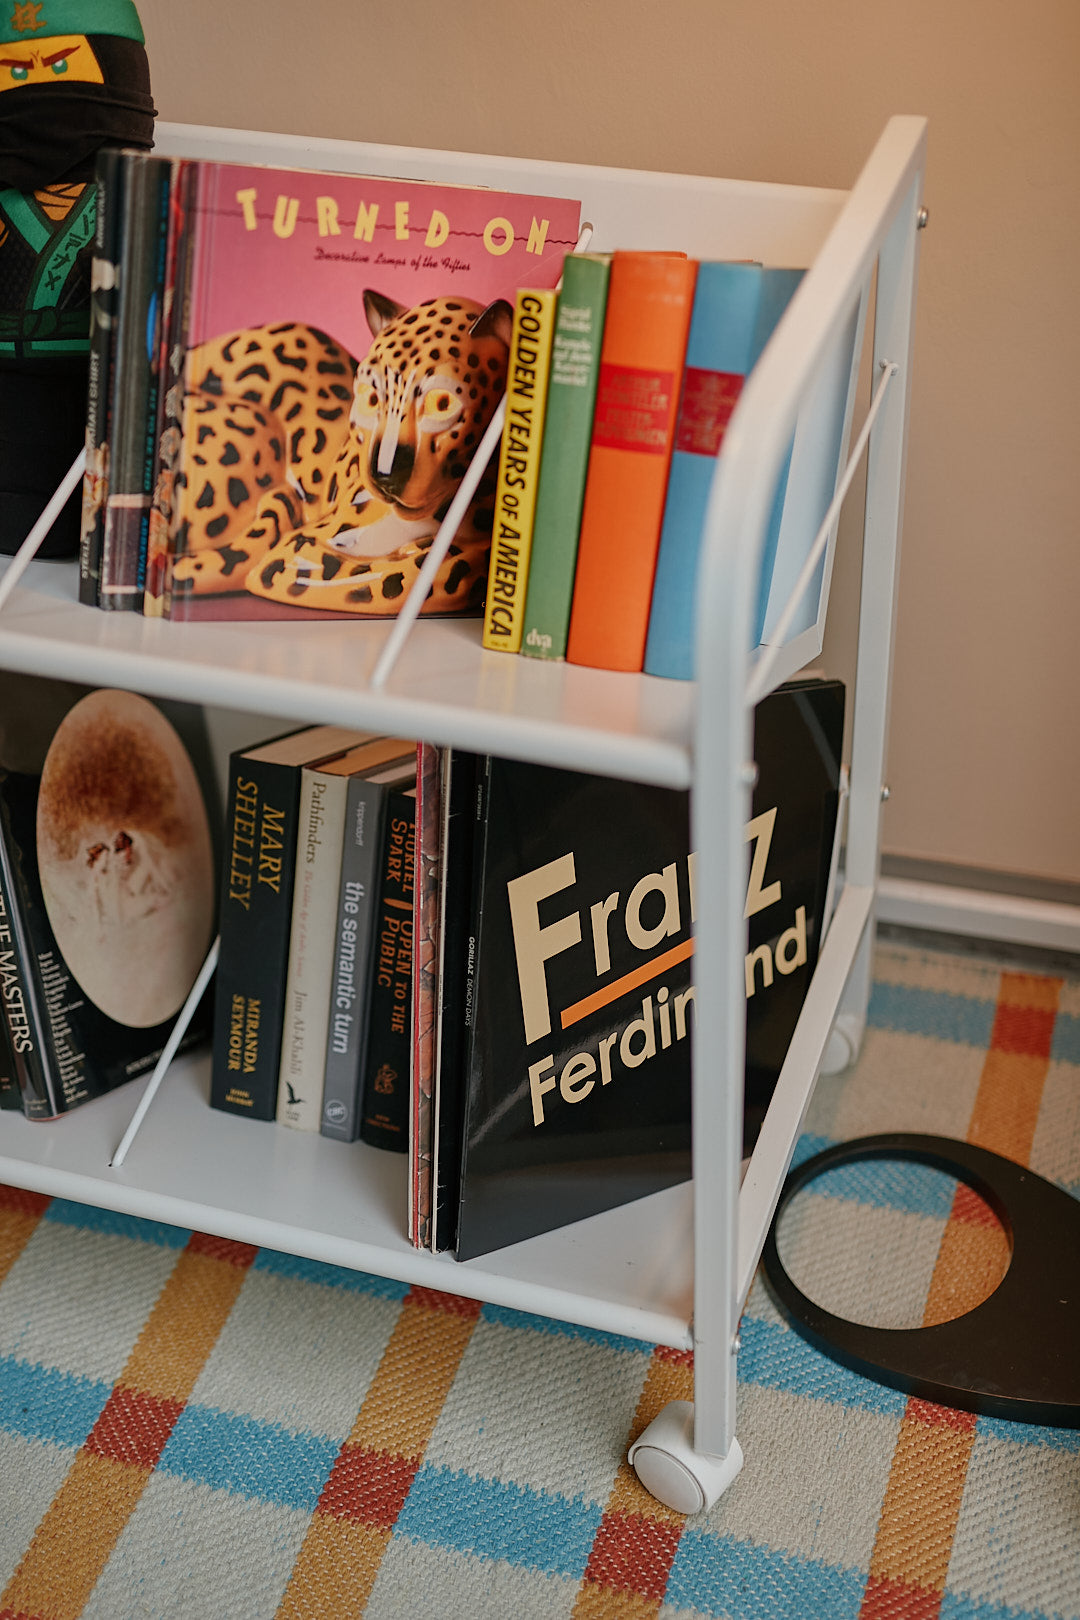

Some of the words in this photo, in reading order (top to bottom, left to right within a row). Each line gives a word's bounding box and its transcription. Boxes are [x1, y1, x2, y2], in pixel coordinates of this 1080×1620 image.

[236, 187, 450, 249] TURNED
[483, 215, 550, 256] ON
[410, 255, 422, 271] of
[422, 256, 438, 269] the
[441, 256, 471, 274] Fifties
[512, 296, 543, 399] GOLDEN
[505, 408, 533, 489] YEARS
[502, 493, 520, 520] OF
[489, 522, 521, 637] AMERICA
[229, 776, 258, 911] SHELLEY
[258, 803, 285, 894] MARY
[306, 781, 327, 865] Pathfinders
[386, 818, 408, 882] SPARK
[344, 881, 365, 914] the
[507, 806, 782, 1046] Fraz
[335, 918, 358, 1010] semantic
[378, 916, 400, 987] PUBLIC
[395, 920, 413, 976] OPEN
[467, 936, 476, 975] GORILLAZ
[0, 950, 34, 1054] MASTERS
[293, 991, 308, 1008] Jim
[391, 1005, 406, 1034] THE
[394, 981, 407, 1000] TO
[464, 1007, 473, 1026] DAYS
[528, 905, 808, 1127] Ferdinnd
[228, 993, 245, 1072] SEYMOUR
[243, 998, 261, 1074] MIRANDA
[332, 1013, 354, 1054] turn
